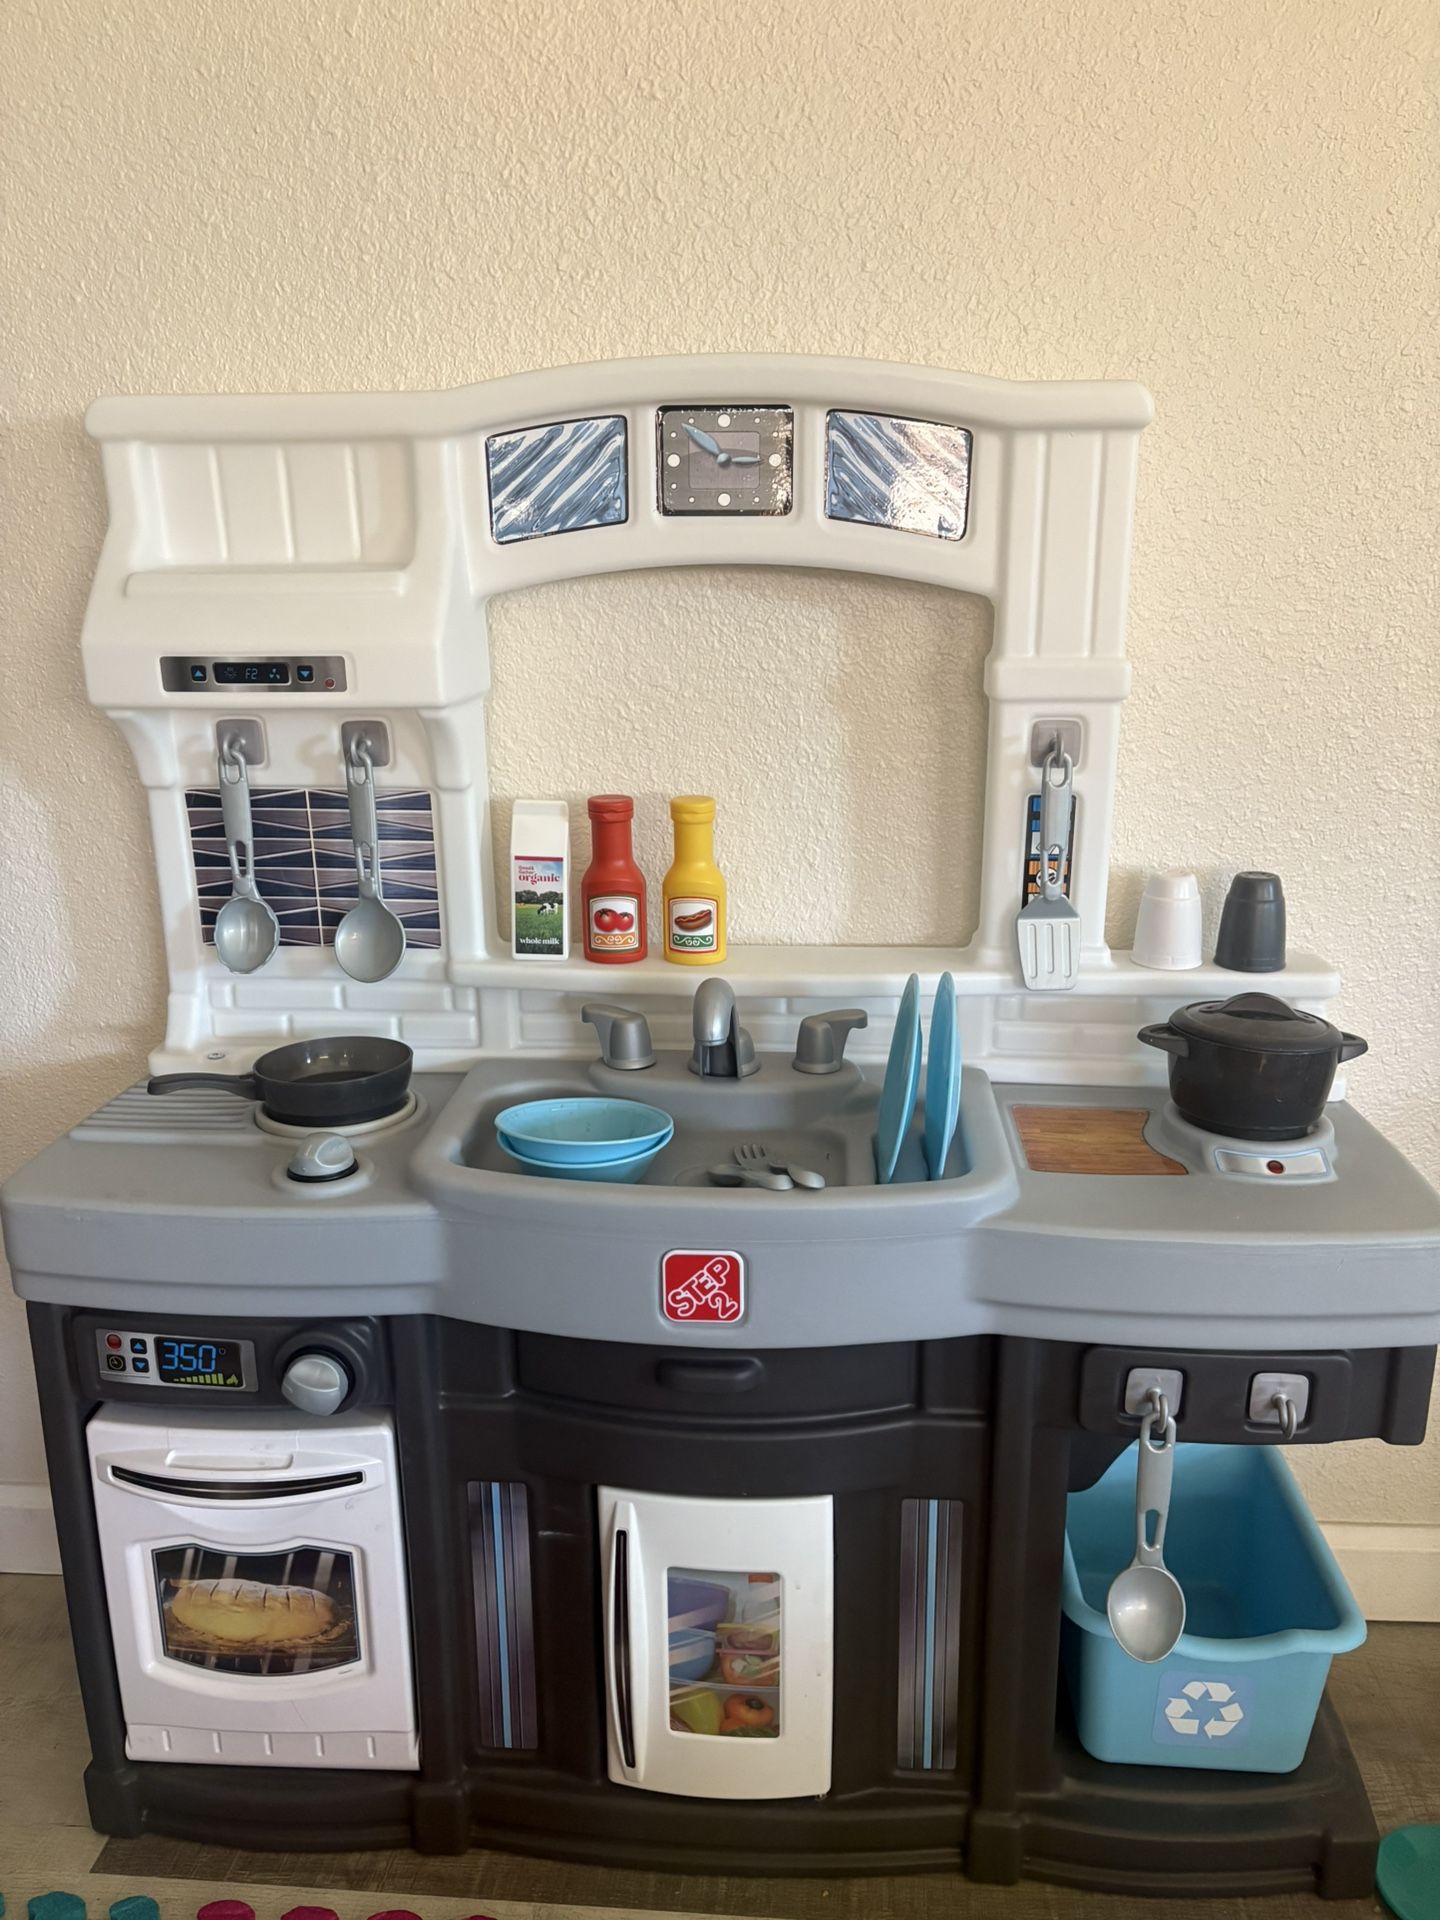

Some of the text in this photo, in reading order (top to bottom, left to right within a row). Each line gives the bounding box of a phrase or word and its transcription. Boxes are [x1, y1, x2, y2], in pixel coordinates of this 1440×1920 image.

[245, 667, 259, 680] F2
[518, 873, 561, 886] organic
[519, 936, 560, 945] whole milk
[668, 1257, 730, 1317] STEP
[708, 1290, 739, 1319] 2
